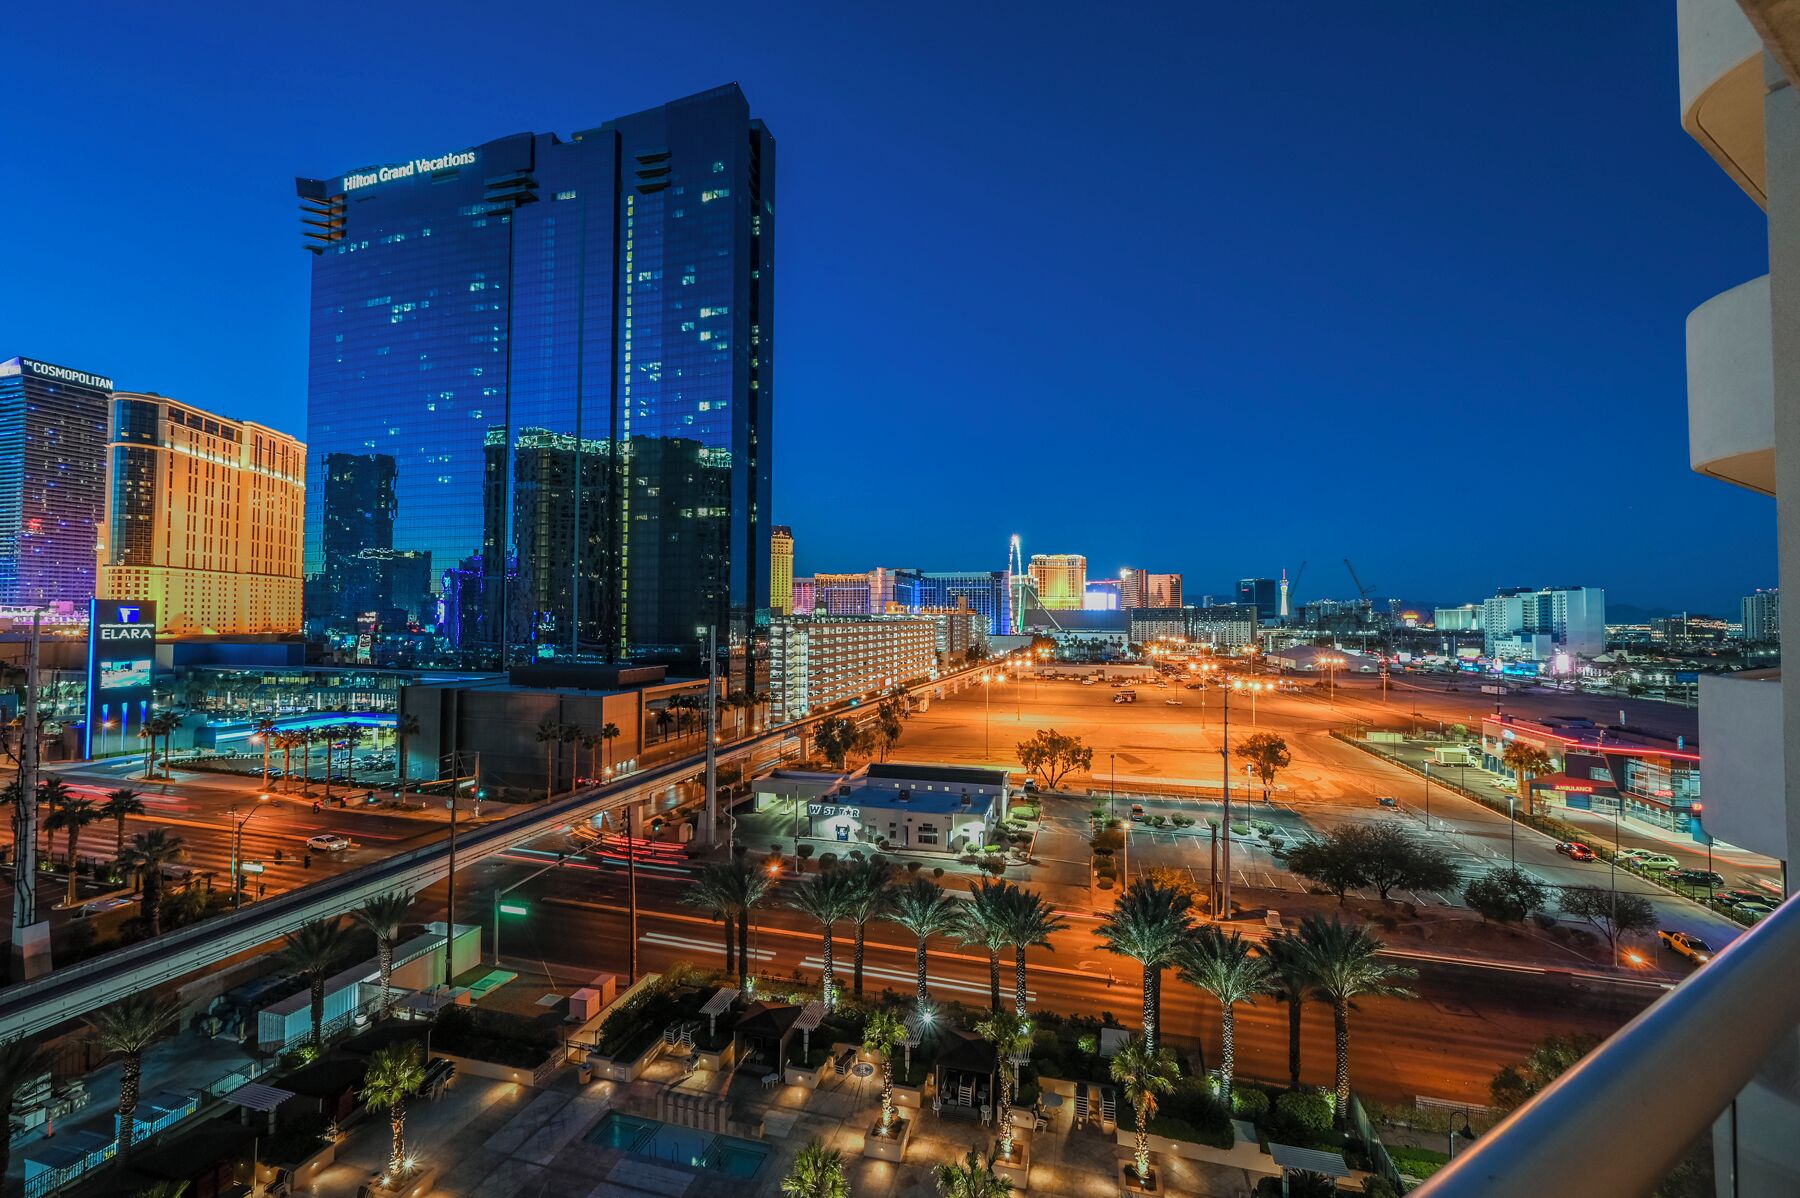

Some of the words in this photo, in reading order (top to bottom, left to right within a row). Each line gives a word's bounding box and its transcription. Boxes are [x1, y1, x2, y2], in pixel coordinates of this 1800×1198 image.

[343, 172, 378, 192] Hilton
[379, 161, 414, 182] Grand
[415, 151, 476, 173] Vacations
[23, 359, 33, 367] THE
[33, 362, 114, 390] COSMOPOLITAN
[101, 628, 152, 640] ELARA
[1555, 785, 1593, 793] AMBULANCE
